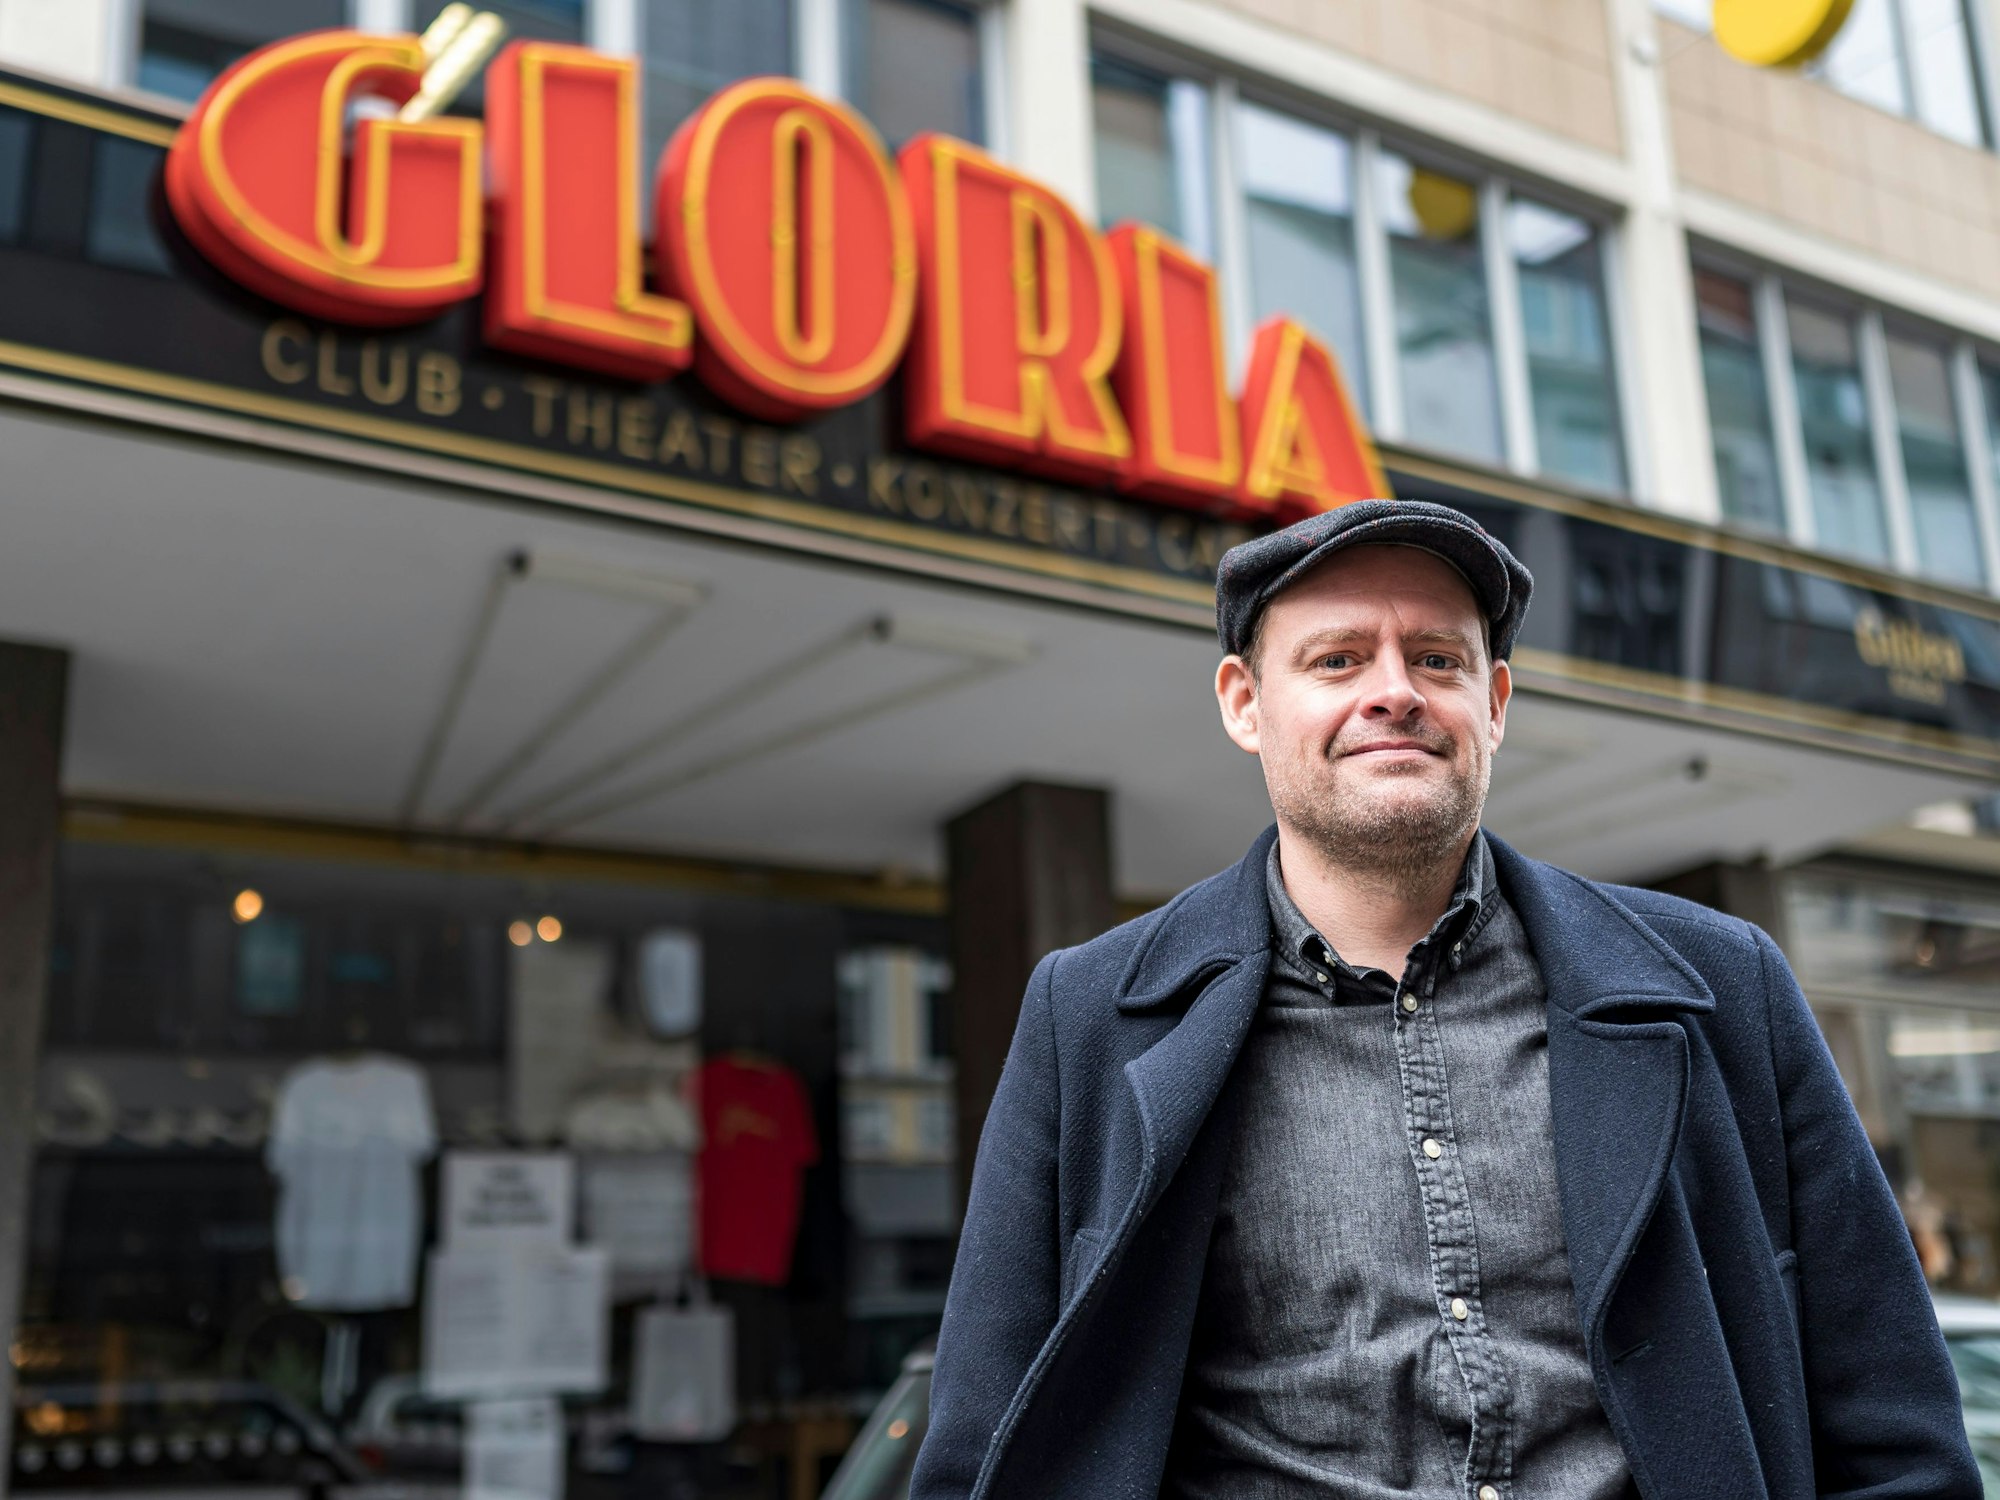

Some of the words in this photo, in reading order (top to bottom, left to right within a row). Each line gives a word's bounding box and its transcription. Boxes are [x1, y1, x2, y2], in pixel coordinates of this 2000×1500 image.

[166, 28, 1392, 524] GLORIA
[260, 318, 463, 417] CLUB
[523, 374, 823, 497] THEATER
[868, 460, 1123, 550] KONZERT
